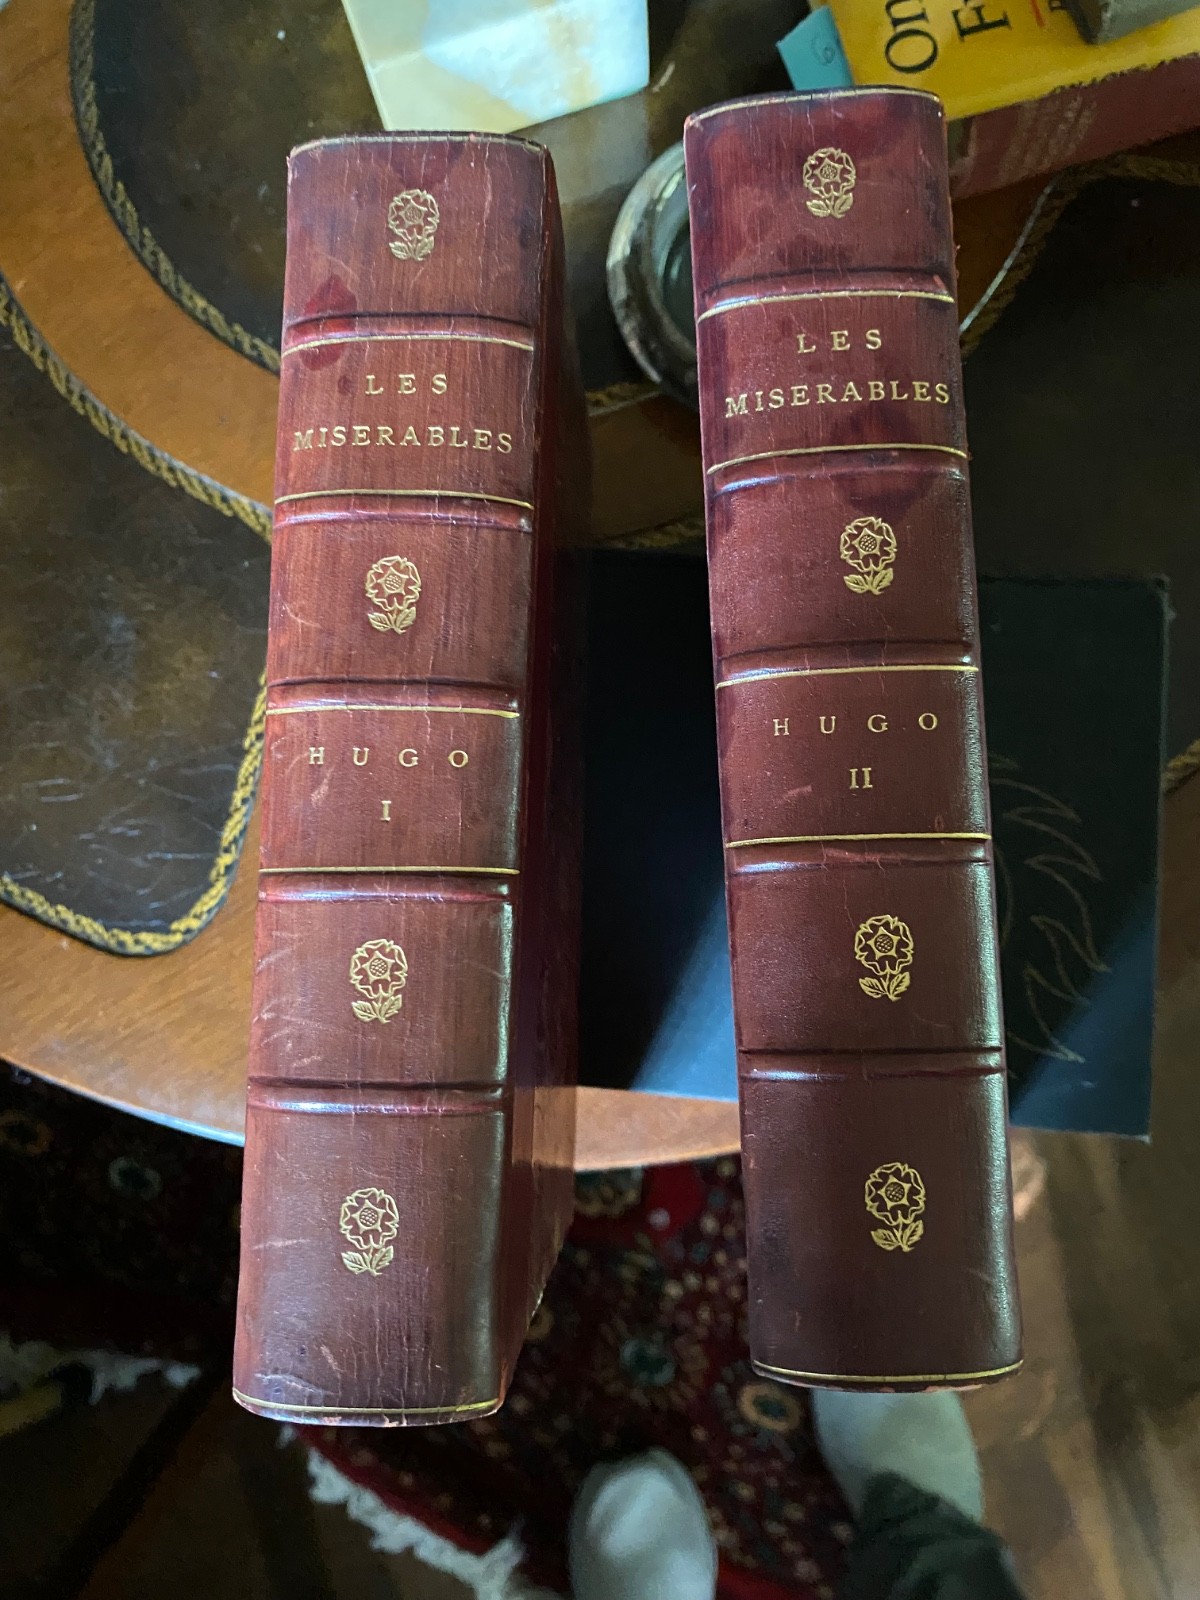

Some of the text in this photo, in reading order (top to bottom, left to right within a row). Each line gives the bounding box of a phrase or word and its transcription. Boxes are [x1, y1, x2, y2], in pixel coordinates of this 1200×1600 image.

[796, 328, 883, 353] LES
[364, 373, 449, 395] LES
[724, 380, 950, 418] MISERABLES
[293, 425, 513, 453] MISERABLES
[772, 712, 939, 737] HUGO
[308, 746, 469, 768] HUGO
[849, 767, 873, 789] II
[380, 799, 392, 822] I
